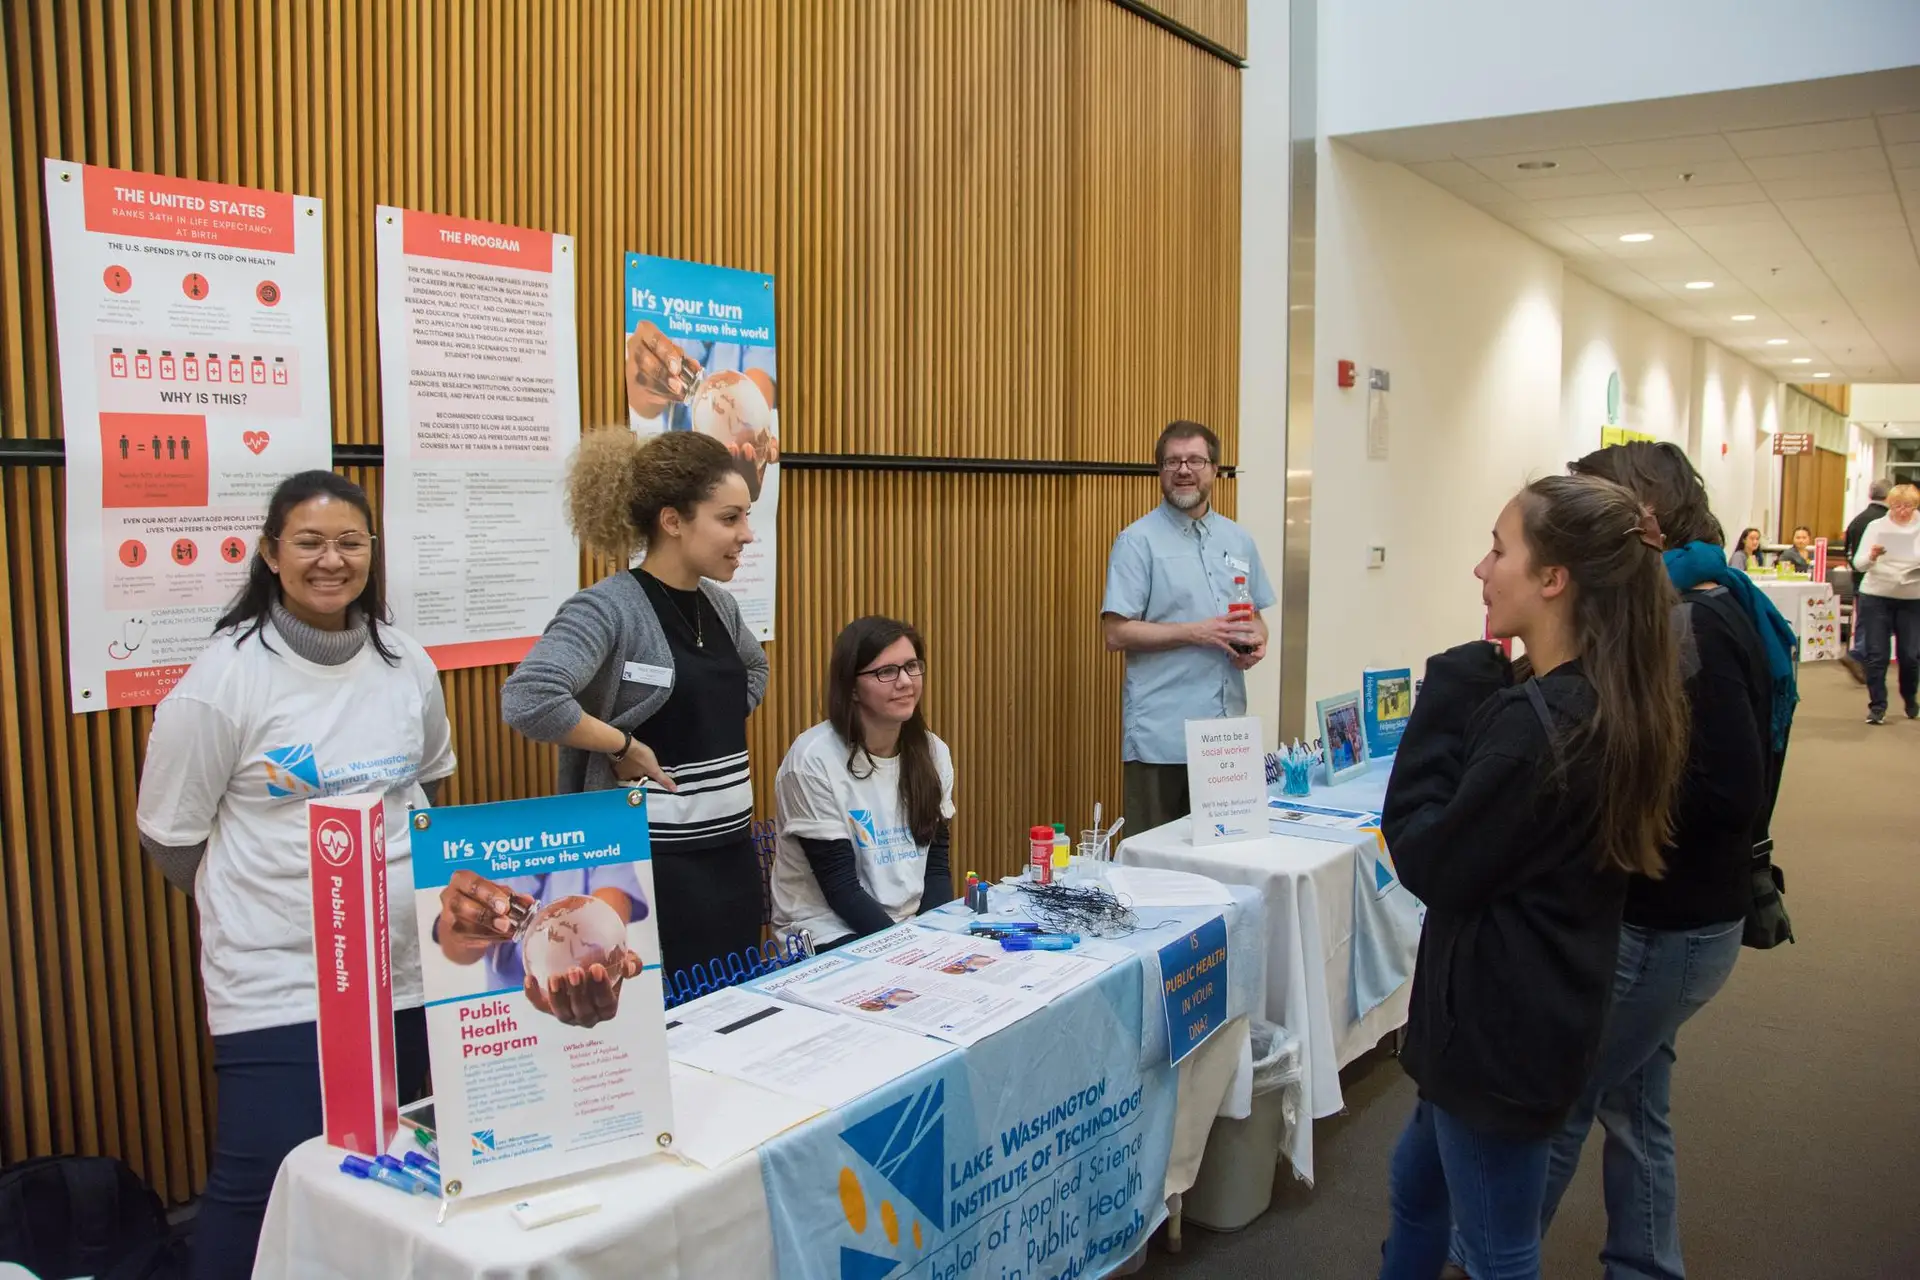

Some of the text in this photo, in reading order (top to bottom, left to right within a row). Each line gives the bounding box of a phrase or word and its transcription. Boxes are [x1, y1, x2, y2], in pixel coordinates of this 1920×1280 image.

[114, 187, 265, 218] THE UNITED STATES
[112, 208, 273, 234] RANKS 34TH IN LIFE EXPECTANCY
[176, 228, 218, 240] AT BIRTH
[439, 229, 520, 252] THE PROGRAM
[108, 242, 123, 250] THE
[144, 246, 174, 255] SPENDS
[204, 252, 216, 260] ITS
[218, 254, 234, 262] GDP
[248, 257, 275, 266] HEALTH
[631, 287, 743, 320] It's your turn
[669, 317, 769, 340] help save the world
[160, 391, 247, 405] WHY IS THIS?
[135, 670, 160, 678] WHAT
[121, 690, 150, 698] CHECK
[1201, 734, 1222, 743] Want
[1233, 732, 1242, 740] be
[349, 754, 408, 771] WASHINGTON
[1201, 746, 1250, 757] social worker
[1208, 772, 1248, 784] counselor?
[443, 829, 585, 861] It's your turn
[491, 844, 621, 872] help save the world
[329, 874, 346, 993] Public Health
[1190, 934, 1199, 950] IS
[1165, 947, 1226, 996] PUBLIC HEALTH
[1182, 982, 1214, 1016] IN YOUR
[459, 1001, 511, 1022] Public
[461, 1017, 518, 1040] Health
[1188, 1014, 1208, 1040] DNA?
[462, 1034, 538, 1058] Program
[950, 1076, 1106, 1191] LAKE WASHINGTON
[950, 1085, 1145, 1228] INSTITUTE OF TECHNOLOGY
[930, 1132, 1143, 1280] helor of Applied Science
[1026, 1214, 1080, 1268] Public
[1087, 1161, 1142, 1227] Health
